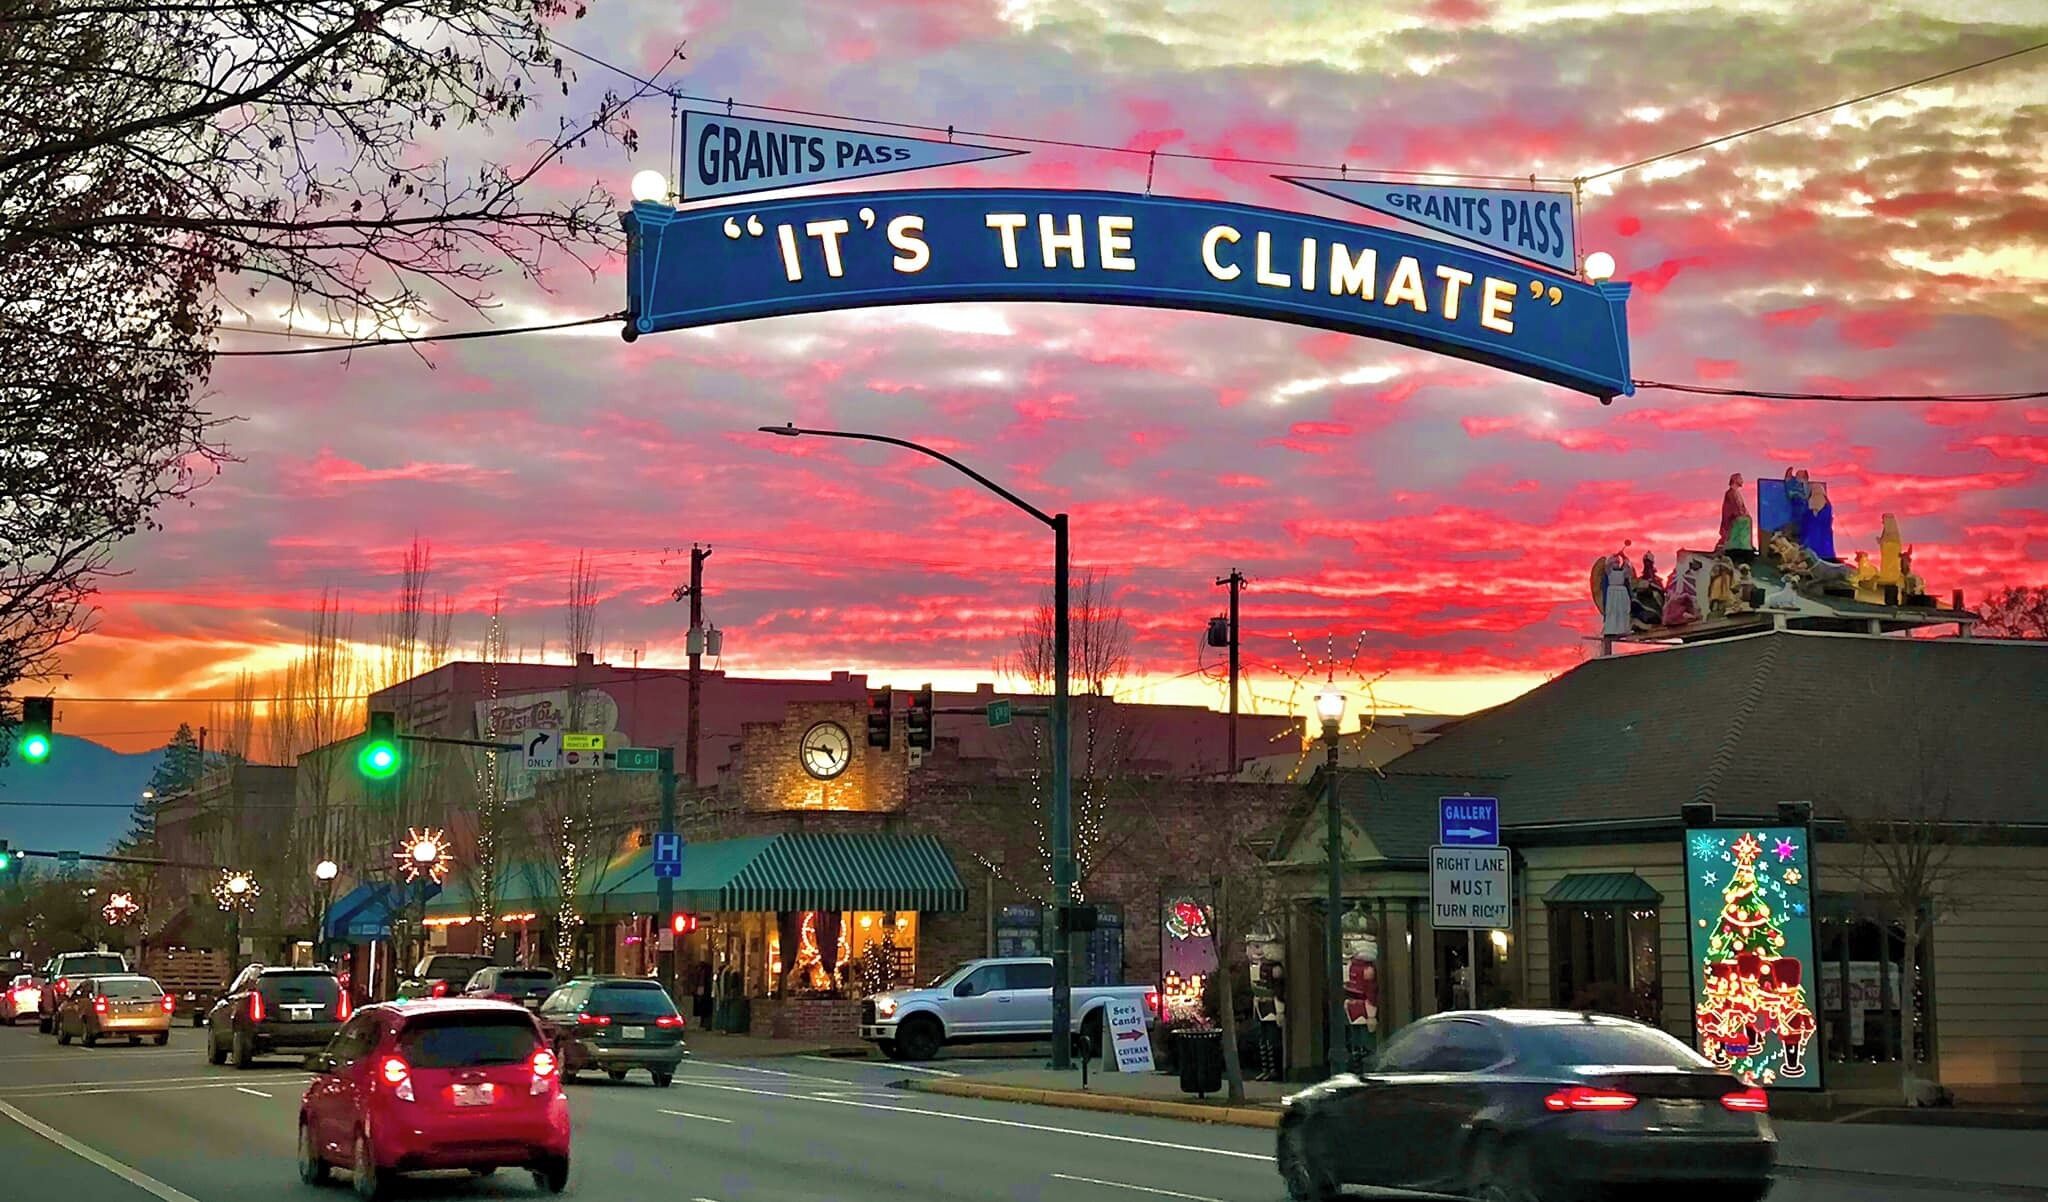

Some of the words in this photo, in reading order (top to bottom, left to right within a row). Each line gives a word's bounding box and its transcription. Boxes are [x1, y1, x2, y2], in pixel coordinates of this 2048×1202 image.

[698, 122, 826, 187] GRANTS
[836, 140, 912, 169] PASS
[1385, 192, 1492, 236] GRANTS
[1501, 199, 1565, 258] PASS
[985, 212, 1136, 272] THE
[527, 759, 553, 768] ONLY
[634, 753, 641, 765] G
[1445, 805, 1493, 820] GALLERY
[657, 835, 679, 861] H
[1436, 857, 1470, 871] RIGHT
[1475, 858, 1505, 872] LANE
[1450, 879, 1493, 896] MUST
[1436, 903, 1467, 917] TURN
[1472, 904, 1507, 918] RIGHT
[1113, 1005, 1136, 1016] See's
[1111, 1016, 1142, 1026] Candy
